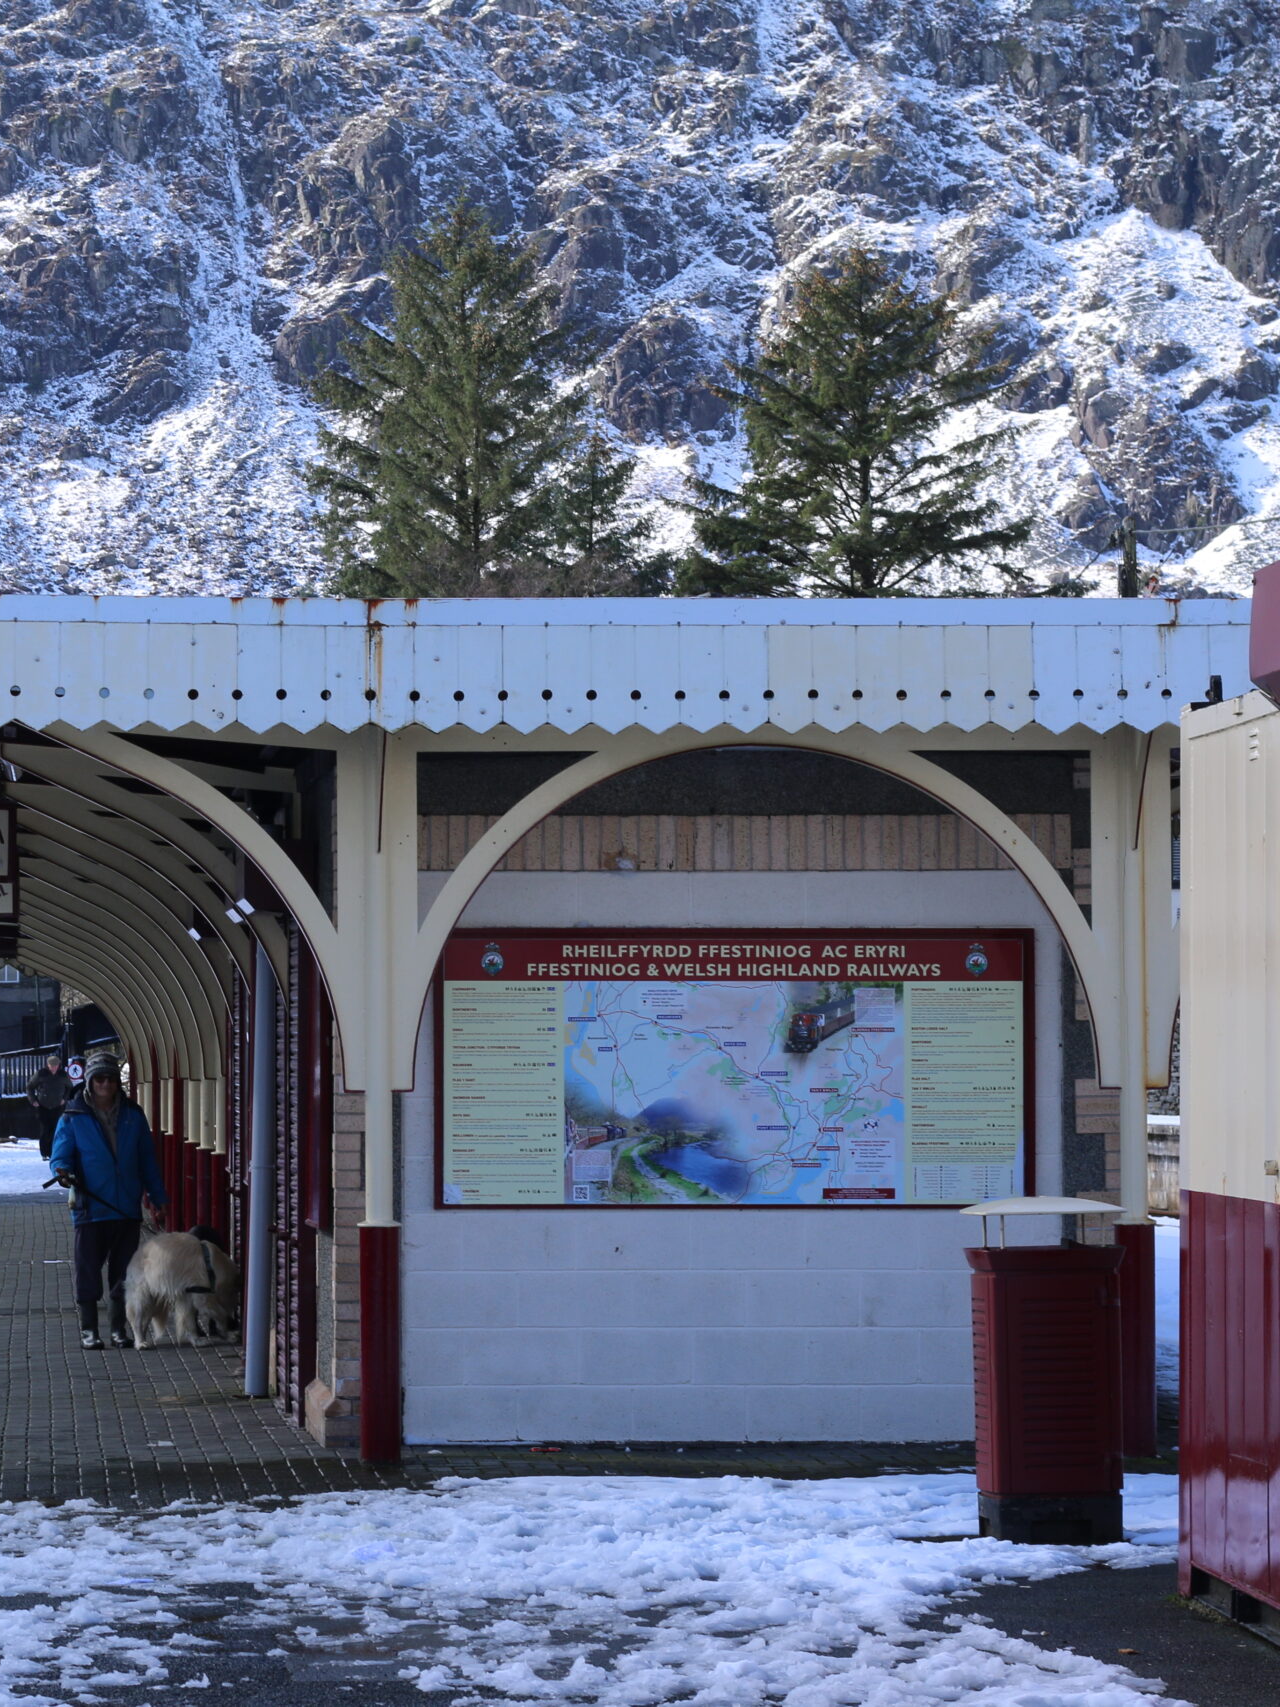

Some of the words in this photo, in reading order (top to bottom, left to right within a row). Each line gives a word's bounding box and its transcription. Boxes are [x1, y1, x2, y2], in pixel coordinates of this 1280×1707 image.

[562, 945, 692, 958] RHEILFFYRDD
[698, 945, 812, 958] FFESTINIOG
[821, 945, 848, 958] AC
[854, 945, 906, 958] ERYRI
[527, 963, 640, 976] FFESTINIOG
[646, 963, 660, 976] &
[663, 963, 731, 976] WELSH
[737, 963, 841, 976] HIGHLAND
[847, 963, 941, 976] RAILWAYS
